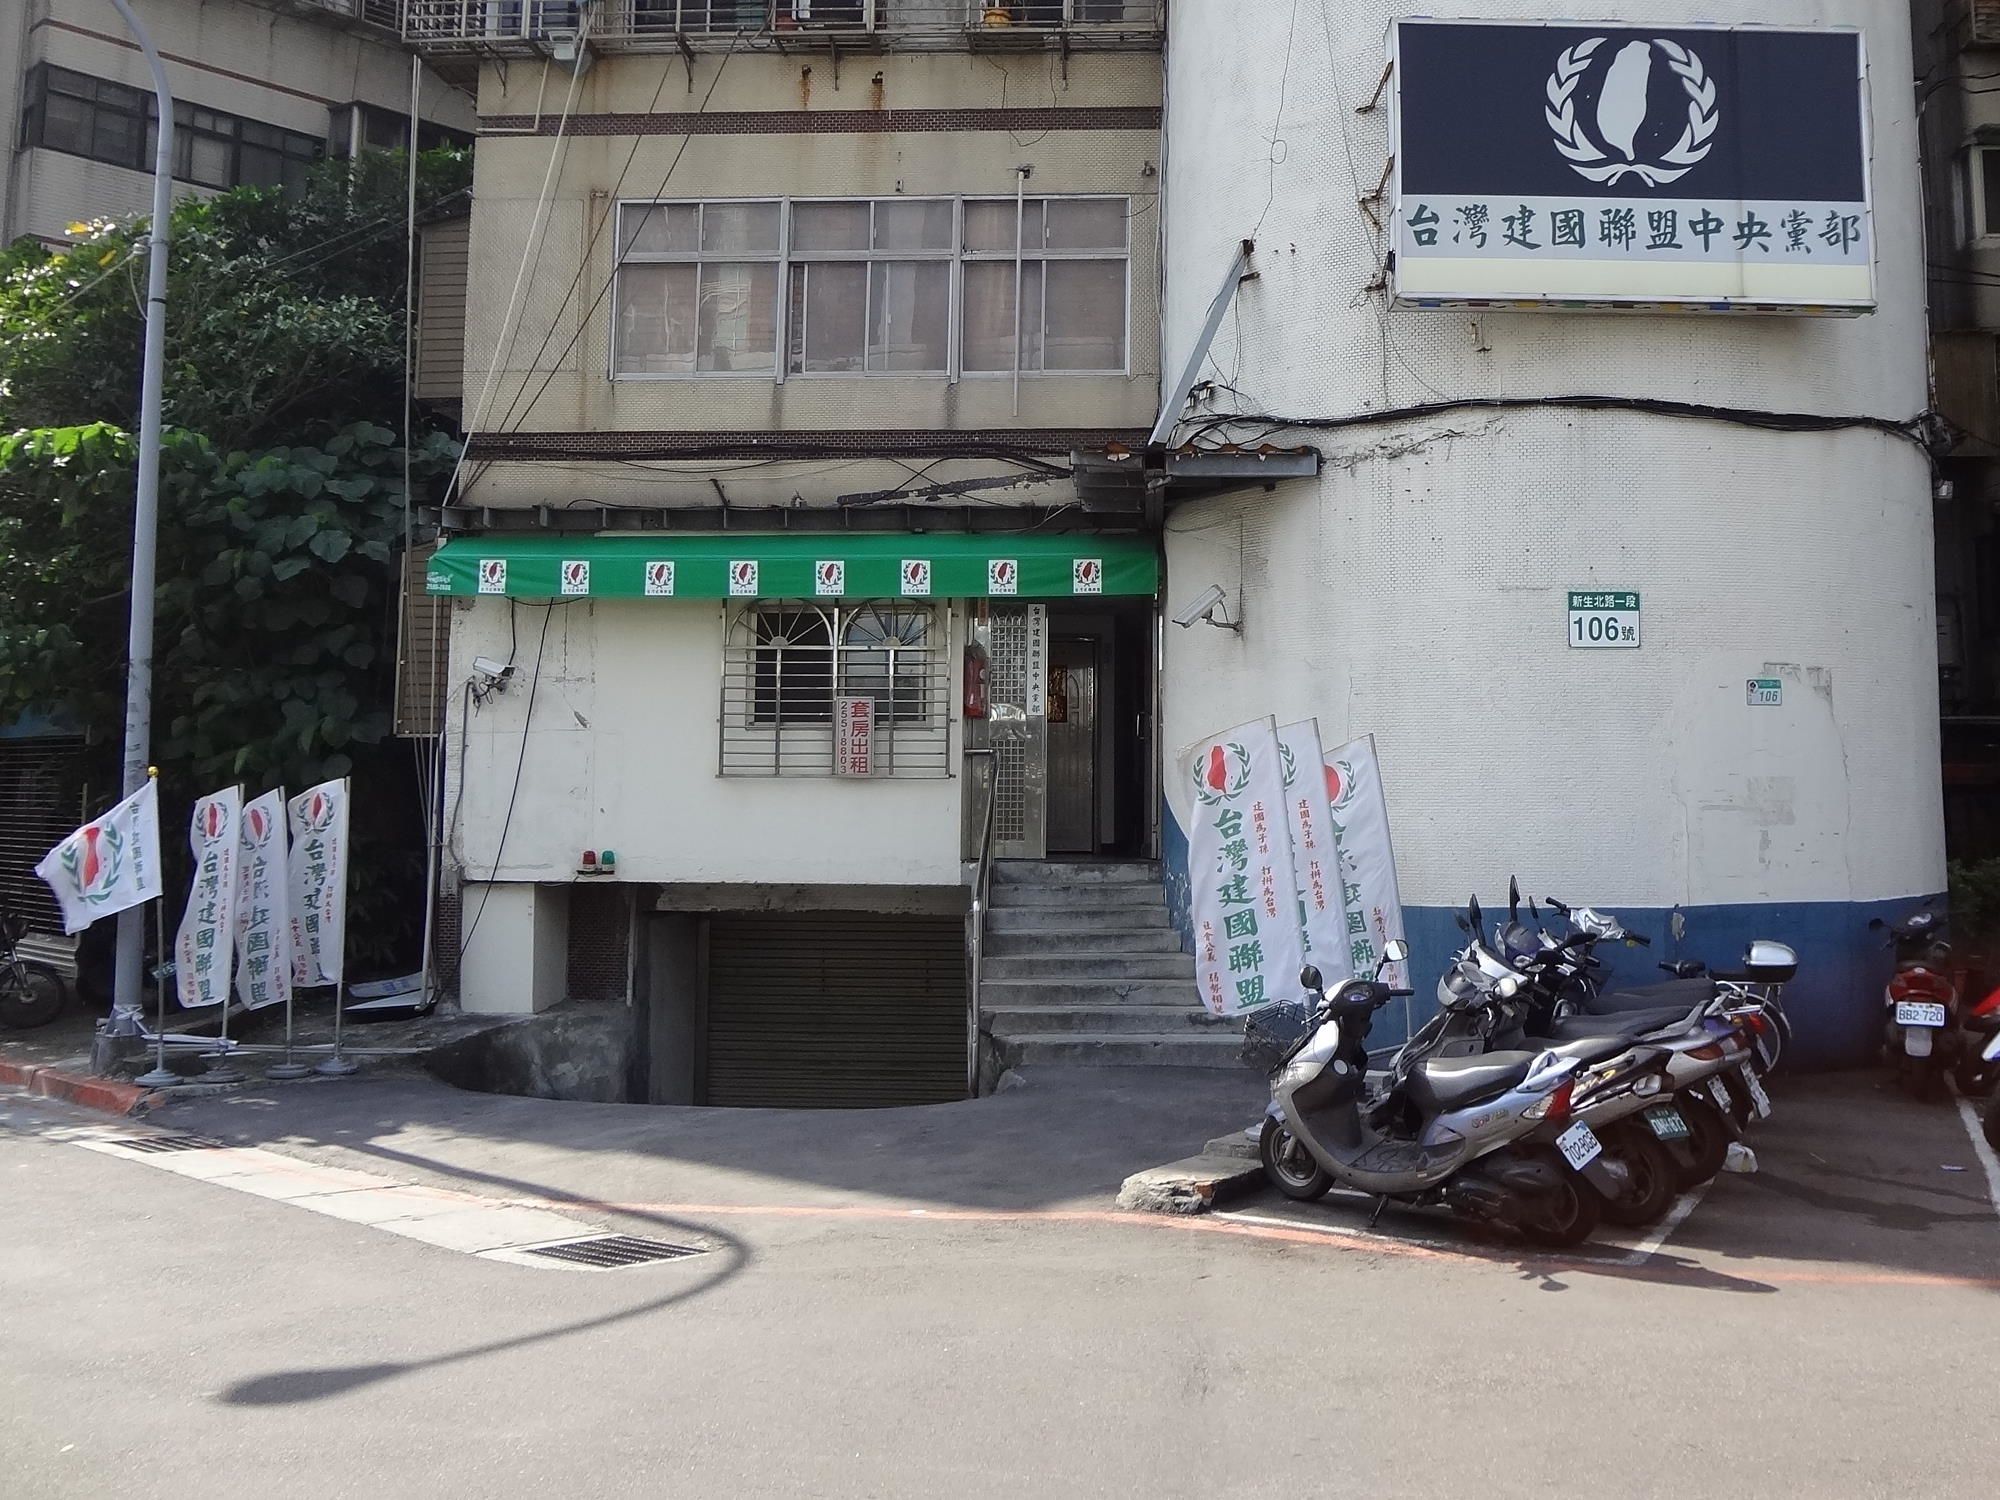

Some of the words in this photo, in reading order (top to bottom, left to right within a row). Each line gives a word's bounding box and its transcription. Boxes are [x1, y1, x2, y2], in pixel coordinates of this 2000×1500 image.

[1405, 202, 1863, 256] 台灣建國聯盟中央黨部
[1572, 594, 1637, 608] 新生北路一段
[1759, 690, 1778, 702] 106
[840, 701, 848, 774] 25518803
[850, 701, 870, 774] 套房出租
[1212, 808, 1271, 1010] 台灣建國聯盟
